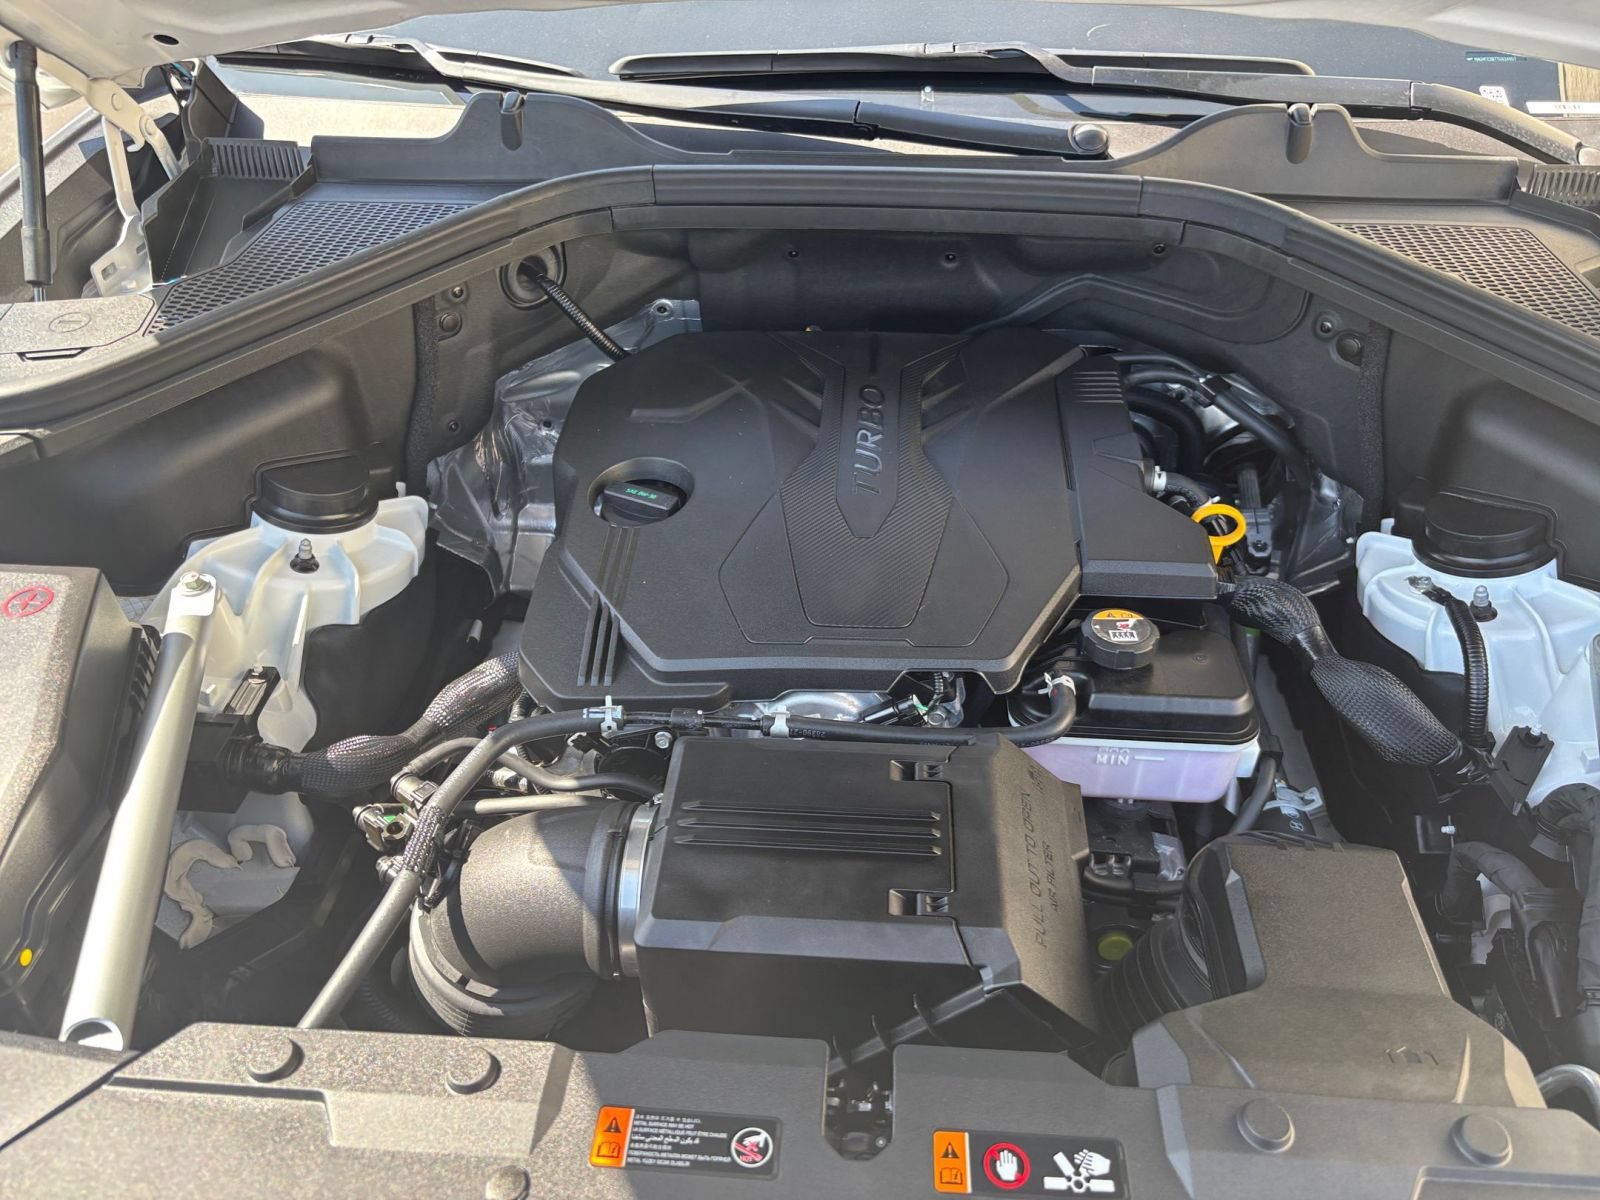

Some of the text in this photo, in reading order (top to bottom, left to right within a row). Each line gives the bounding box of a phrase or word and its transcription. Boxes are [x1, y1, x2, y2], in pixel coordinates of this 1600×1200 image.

[853, 384, 885, 495] TURBO
[1096, 753, 1129, 765] MIN
[1021, 792, 1047, 949] PULL OUT TO OPEN
